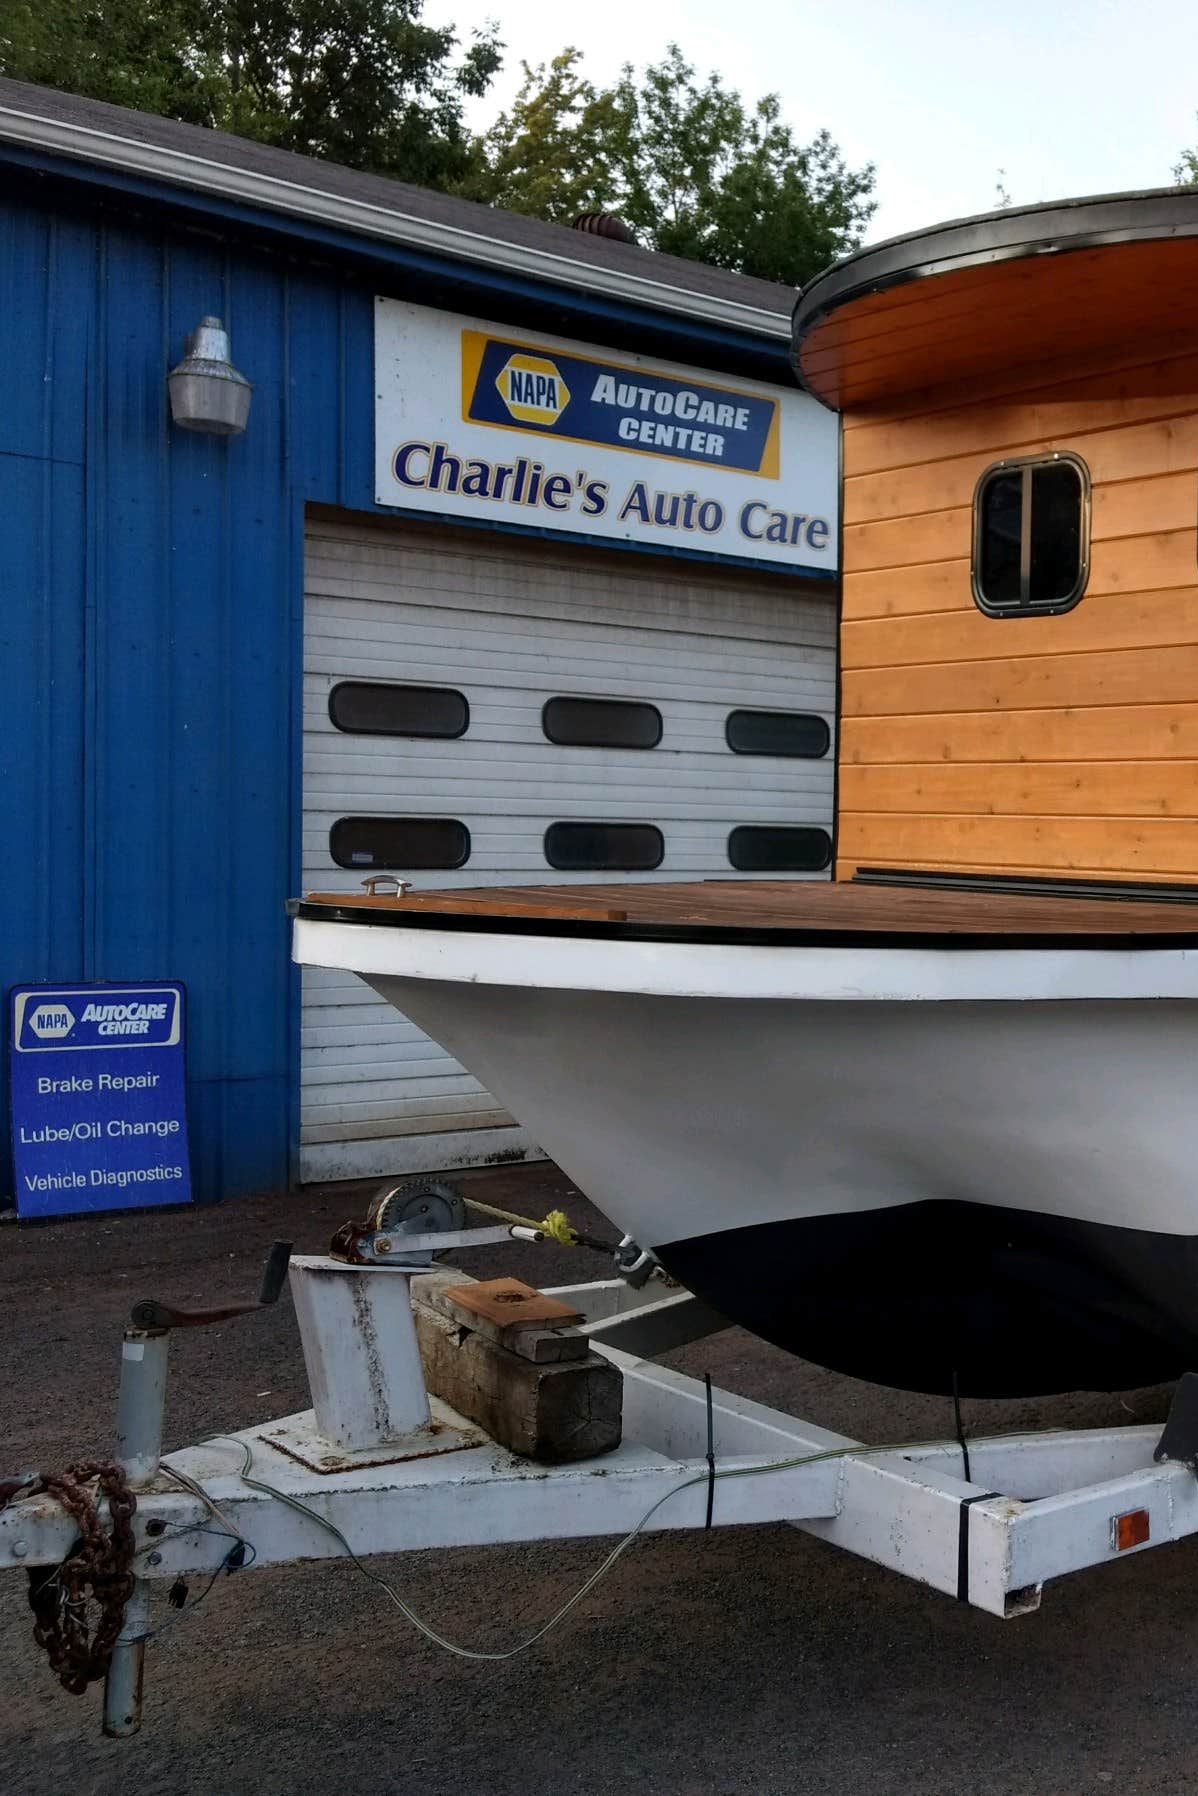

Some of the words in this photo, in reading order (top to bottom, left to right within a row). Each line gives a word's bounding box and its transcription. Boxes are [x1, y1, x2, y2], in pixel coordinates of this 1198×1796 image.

[510, 369, 558, 410] NAPA
[618, 417, 724, 457] CENTER
[392, 441, 609, 516] Charlie's
[618, 481, 725, 534] Auto
[738, 500, 830, 550] Care
[37, 1013, 68, 1030] NAPA
[98, 1020, 149, 1036] CENTER
[38, 1076, 93, 1094] Brake
[98, 1072, 160, 1093] Repair
[20, 1122, 101, 1143] Lube/Oil
[107, 1120, 180, 1137] Change
[25, 1171, 86, 1191] Vehicle
[91, 1164, 183, 1187] Diagnostics
